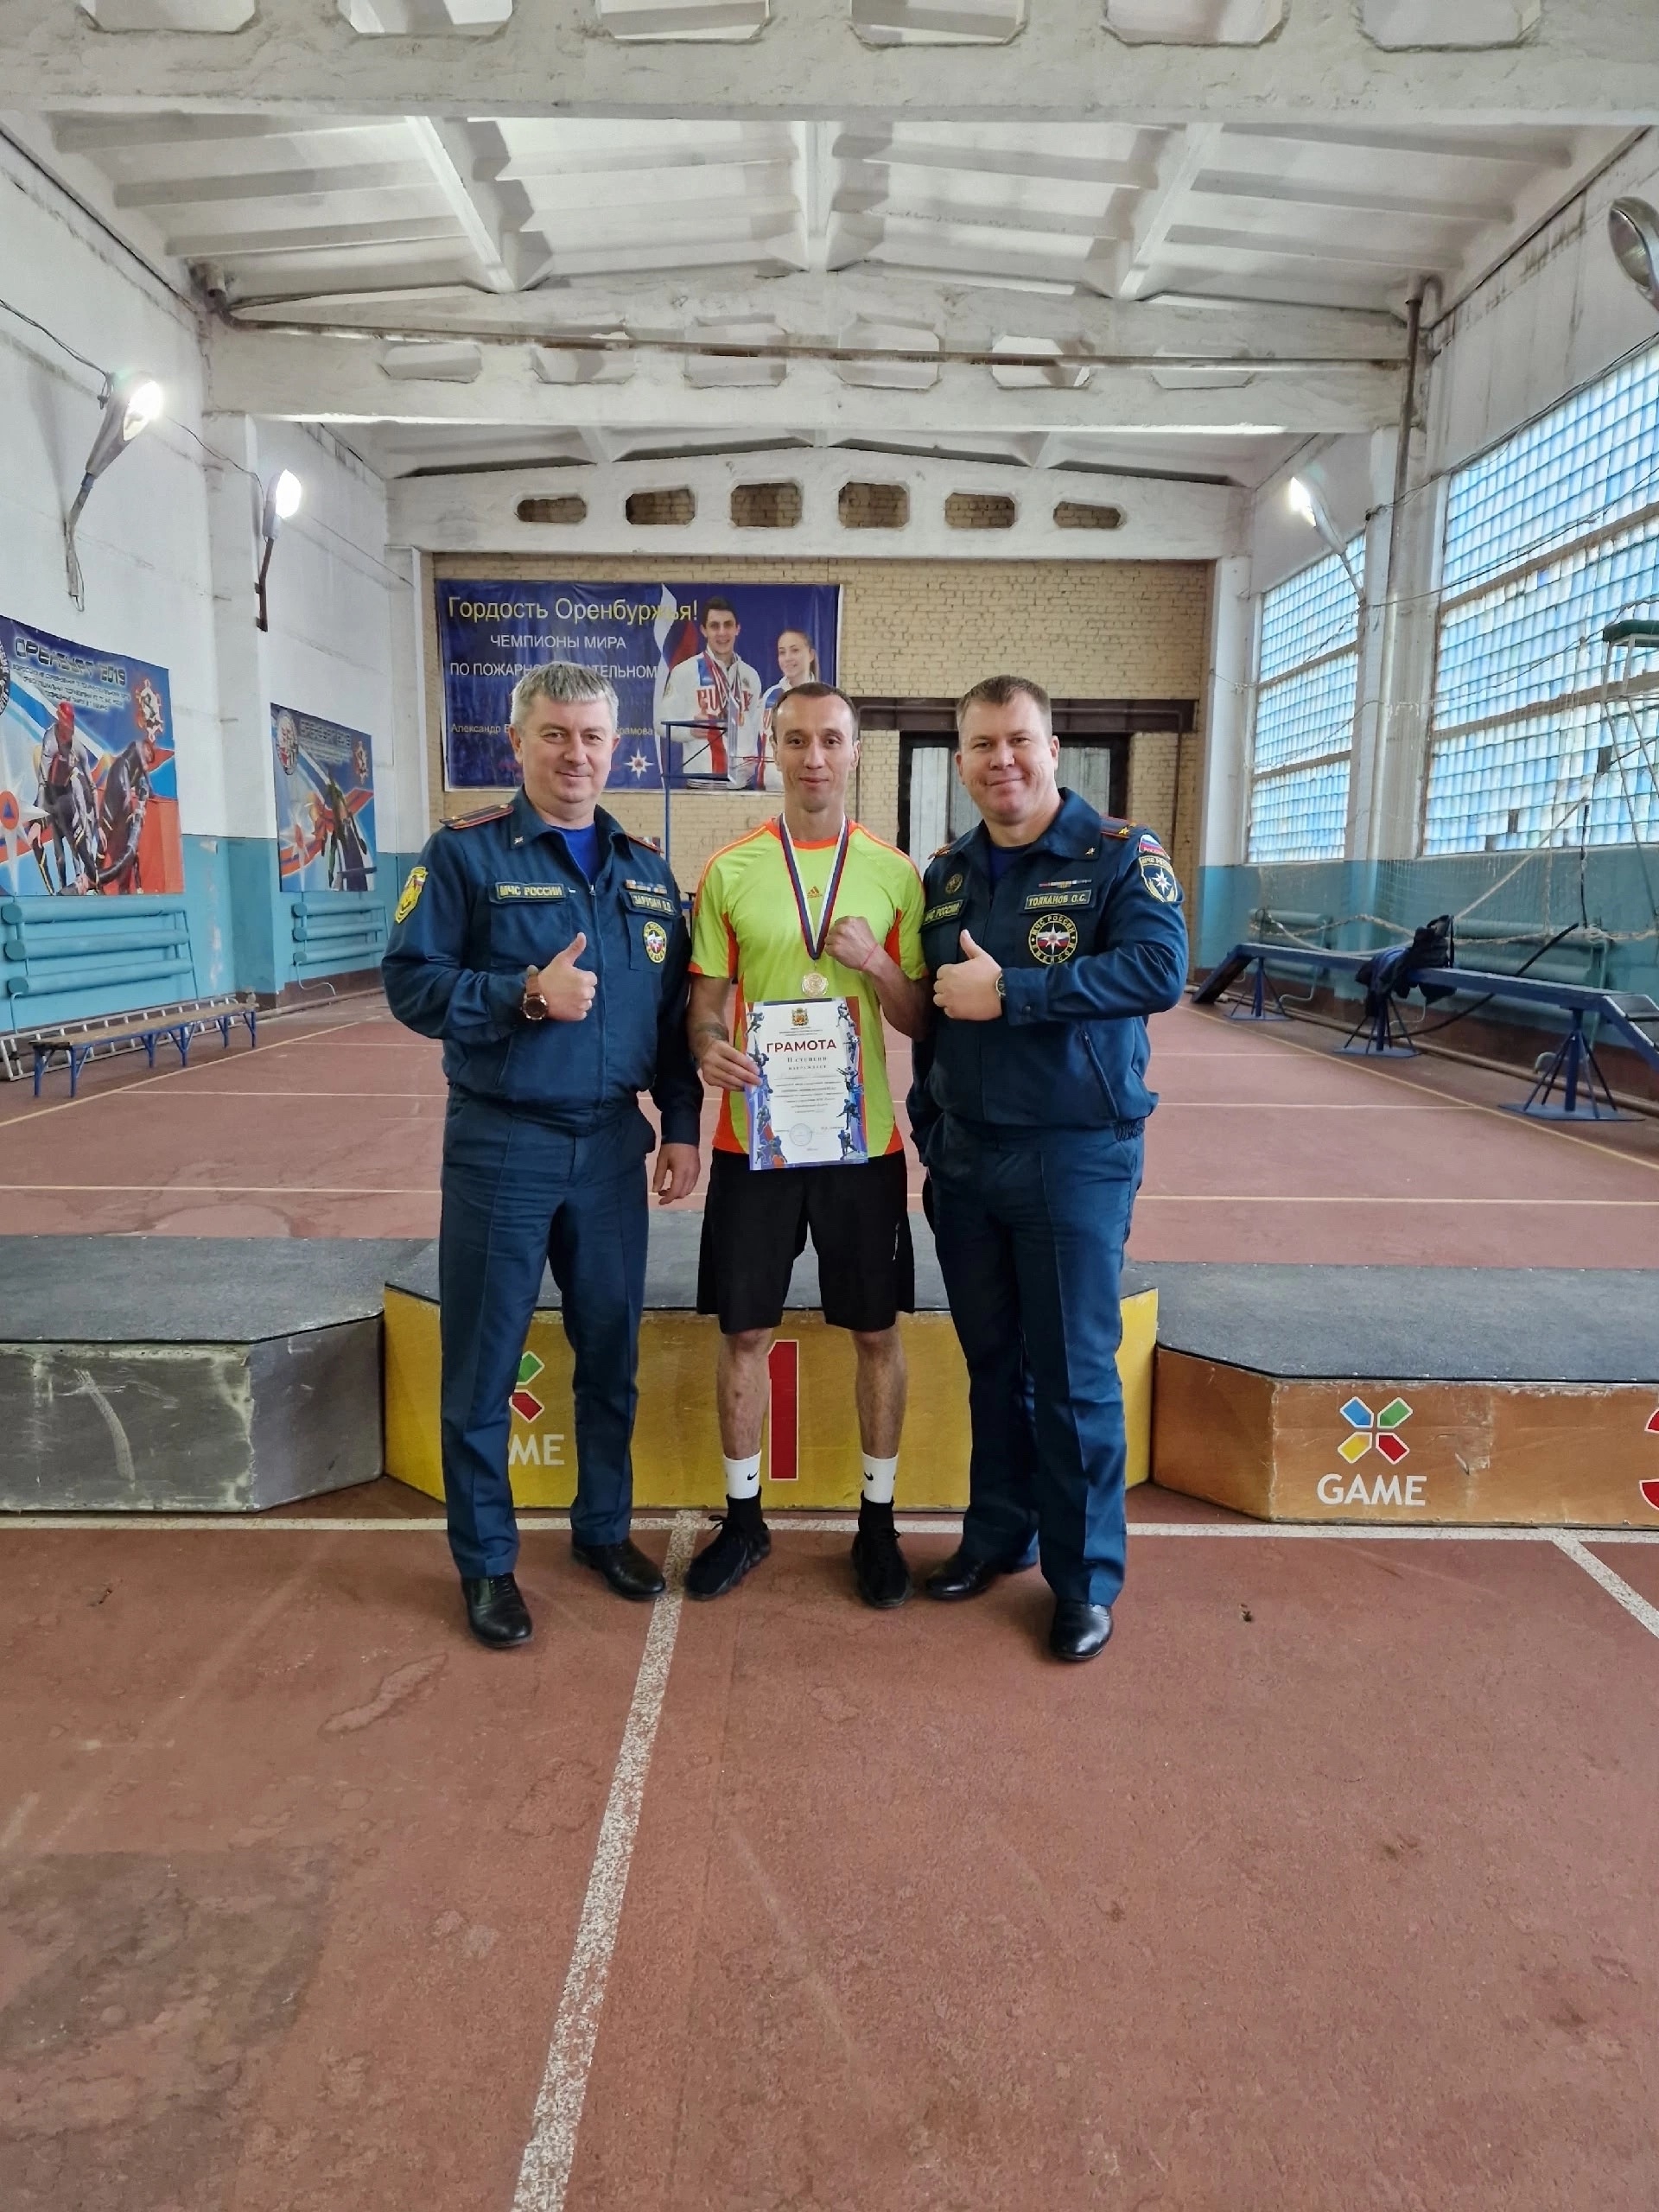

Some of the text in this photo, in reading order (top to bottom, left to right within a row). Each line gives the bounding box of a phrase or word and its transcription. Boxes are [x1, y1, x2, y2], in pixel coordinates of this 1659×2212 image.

[448, 596, 698, 626] Гордость Оренбуржья!
[490, 634, 626, 648] ЧЕМПИОНЫ МИРА
[450, 663, 470, 676] ПО
[590, 664, 658, 677] ТЕЛЬНОМ
[451, 723, 501, 735] Александр
[499, 885, 563, 896] МЧС РОССИИ
[1028, 894, 1068, 906] ТОЛКАНОВ
[766, 1039, 837, 1053] ГРАМОТА
[767, 1339, 799, 1480] 1
[508, 1433, 565, 1465] ME
[1317, 1473, 1427, 1506] GAME
